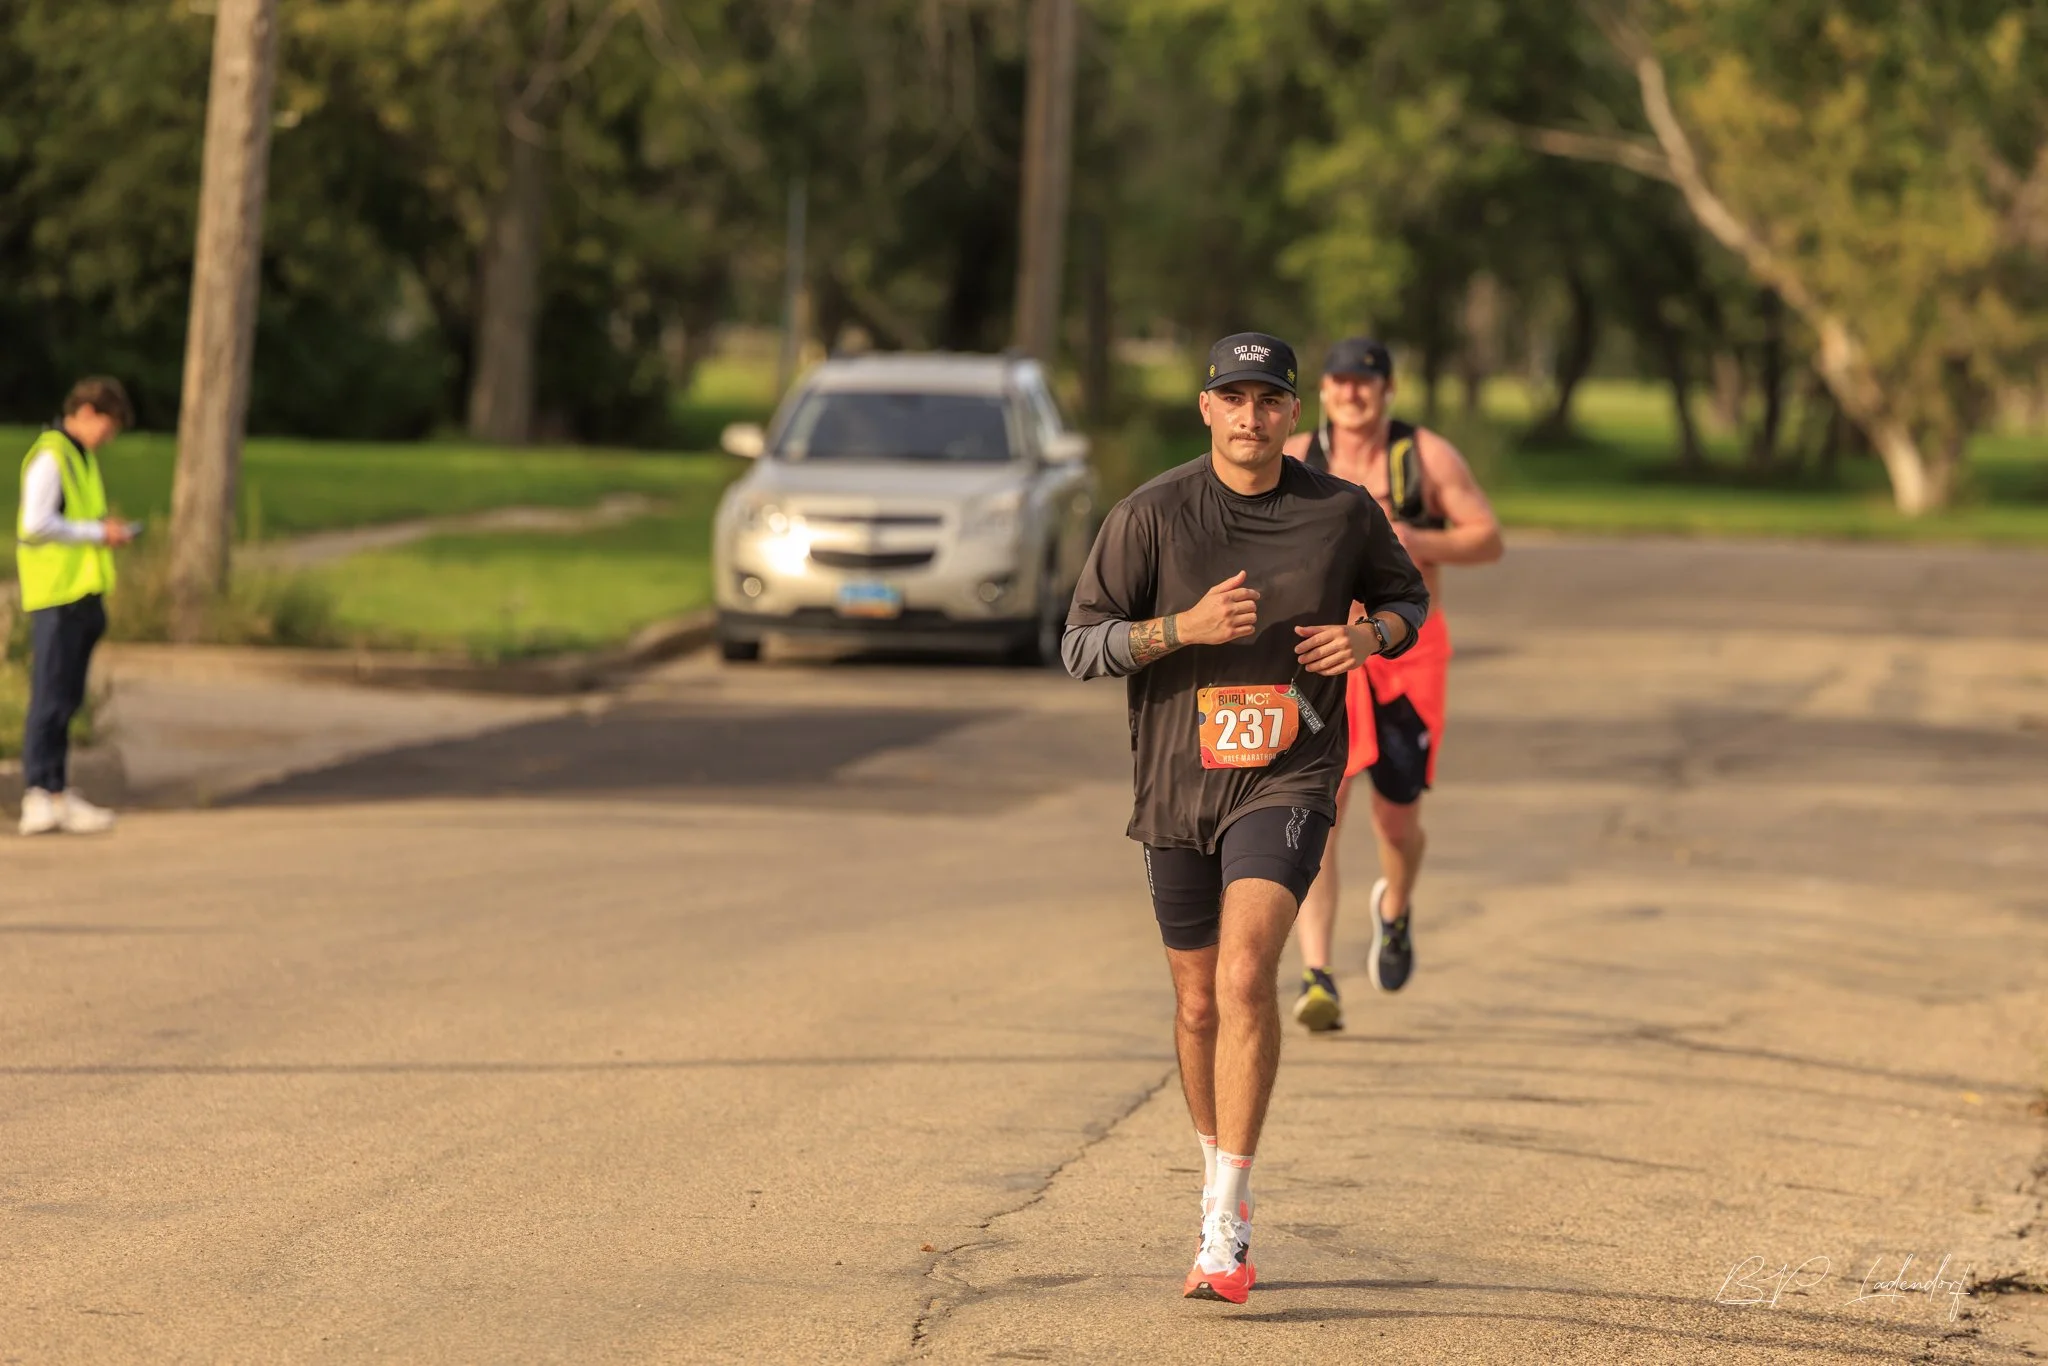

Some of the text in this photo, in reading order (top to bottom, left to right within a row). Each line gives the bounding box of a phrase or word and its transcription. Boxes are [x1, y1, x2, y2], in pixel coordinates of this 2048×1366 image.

[1234, 345, 1271, 356] GO ONE
[1239, 353, 1265, 362] MORE
[1215, 708, 1283, 750] 237
[1223, 754, 1239, 763] HALF
